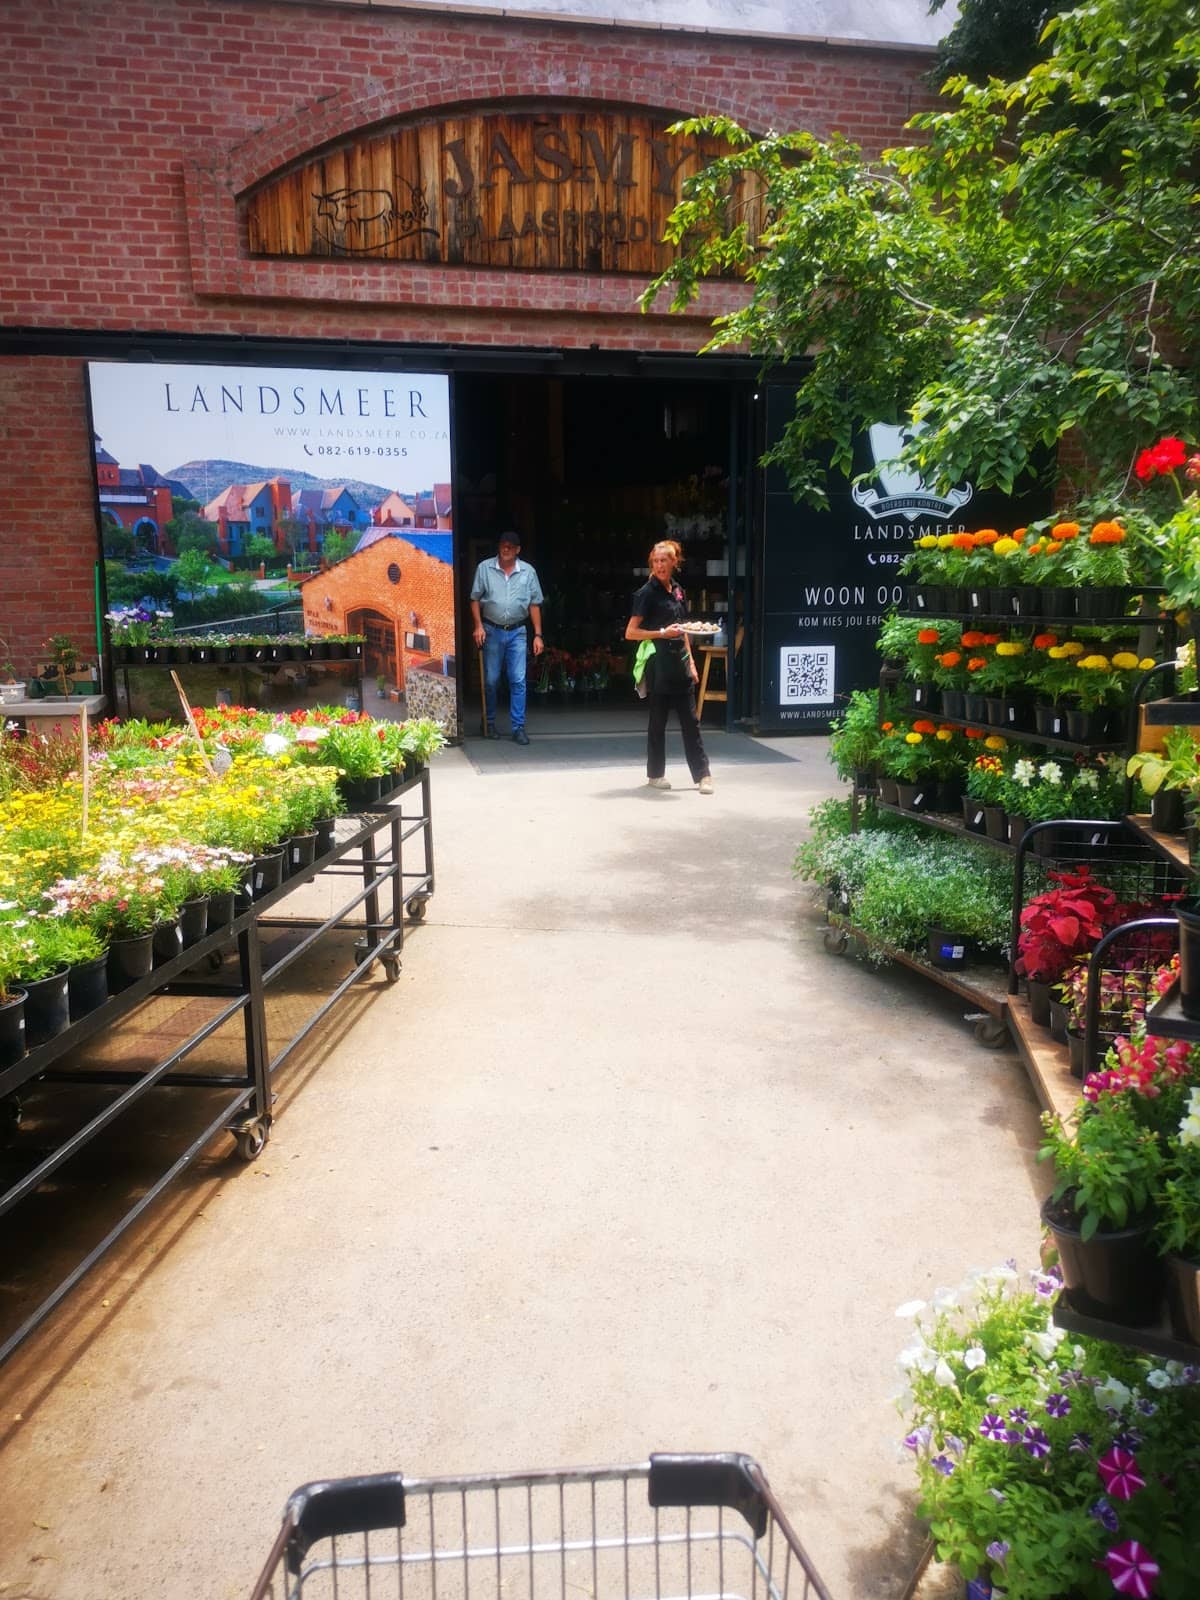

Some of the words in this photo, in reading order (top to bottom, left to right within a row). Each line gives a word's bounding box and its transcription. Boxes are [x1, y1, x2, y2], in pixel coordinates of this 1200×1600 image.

[458, 208, 676, 247] PLAASPRODU
[165, 383, 429, 418] LANDSMEER
[318, 446, 409, 457] 082-619-0355
[804, 585, 866, 606] WOON
[877, 585, 903, 605] OO
[798, 616, 819, 627] KOM
[823, 616, 843, 627] KIES
[846, 615, 863, 628] JOU
[780, 709, 845, 720] WWW.LANDSMEER
